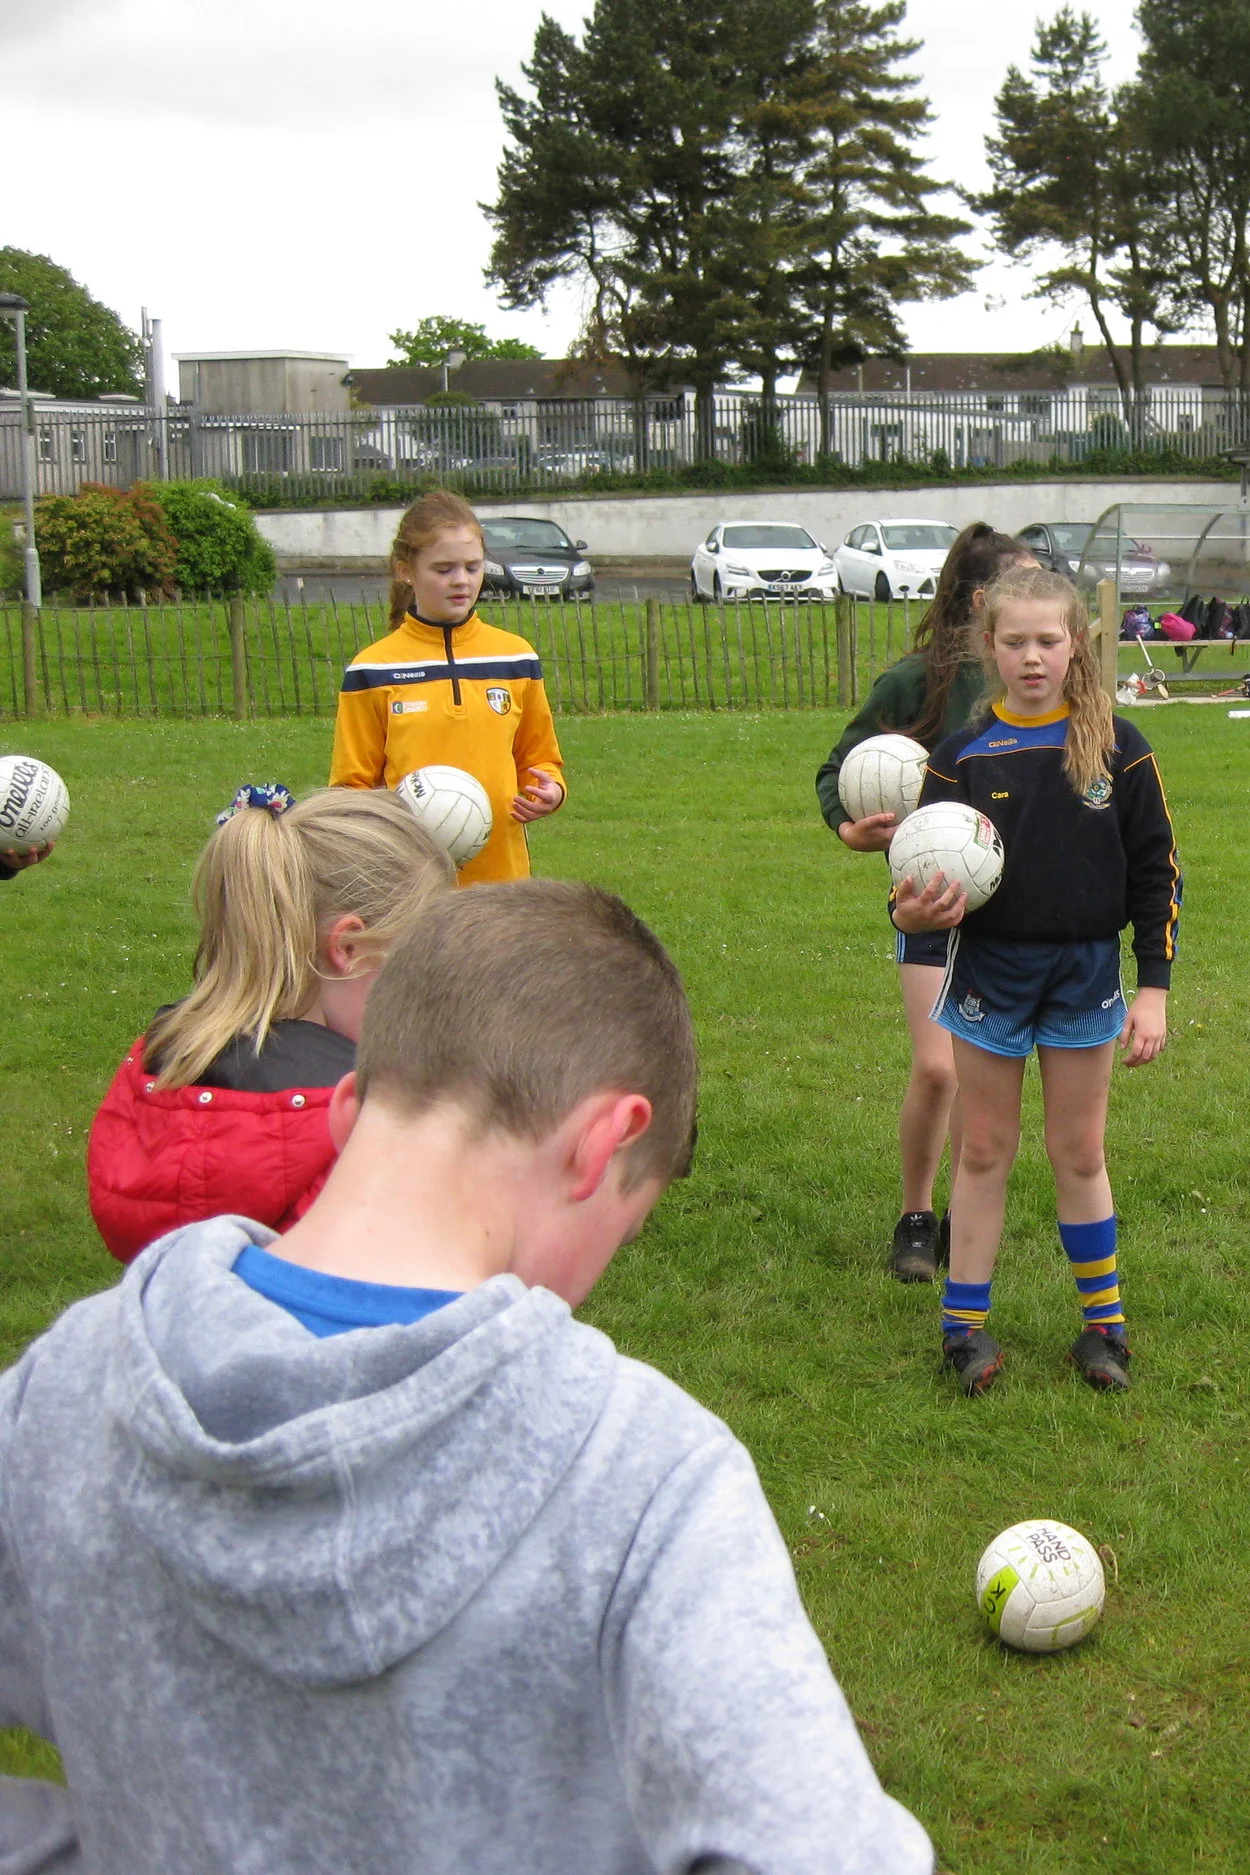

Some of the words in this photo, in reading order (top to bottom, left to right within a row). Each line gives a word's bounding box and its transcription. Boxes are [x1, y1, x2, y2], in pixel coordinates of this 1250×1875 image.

[991, 791, 1009, 800] Cara
[1026, 1533, 1058, 1564] PASS
[1036, 1527, 1072, 1562] HAND
